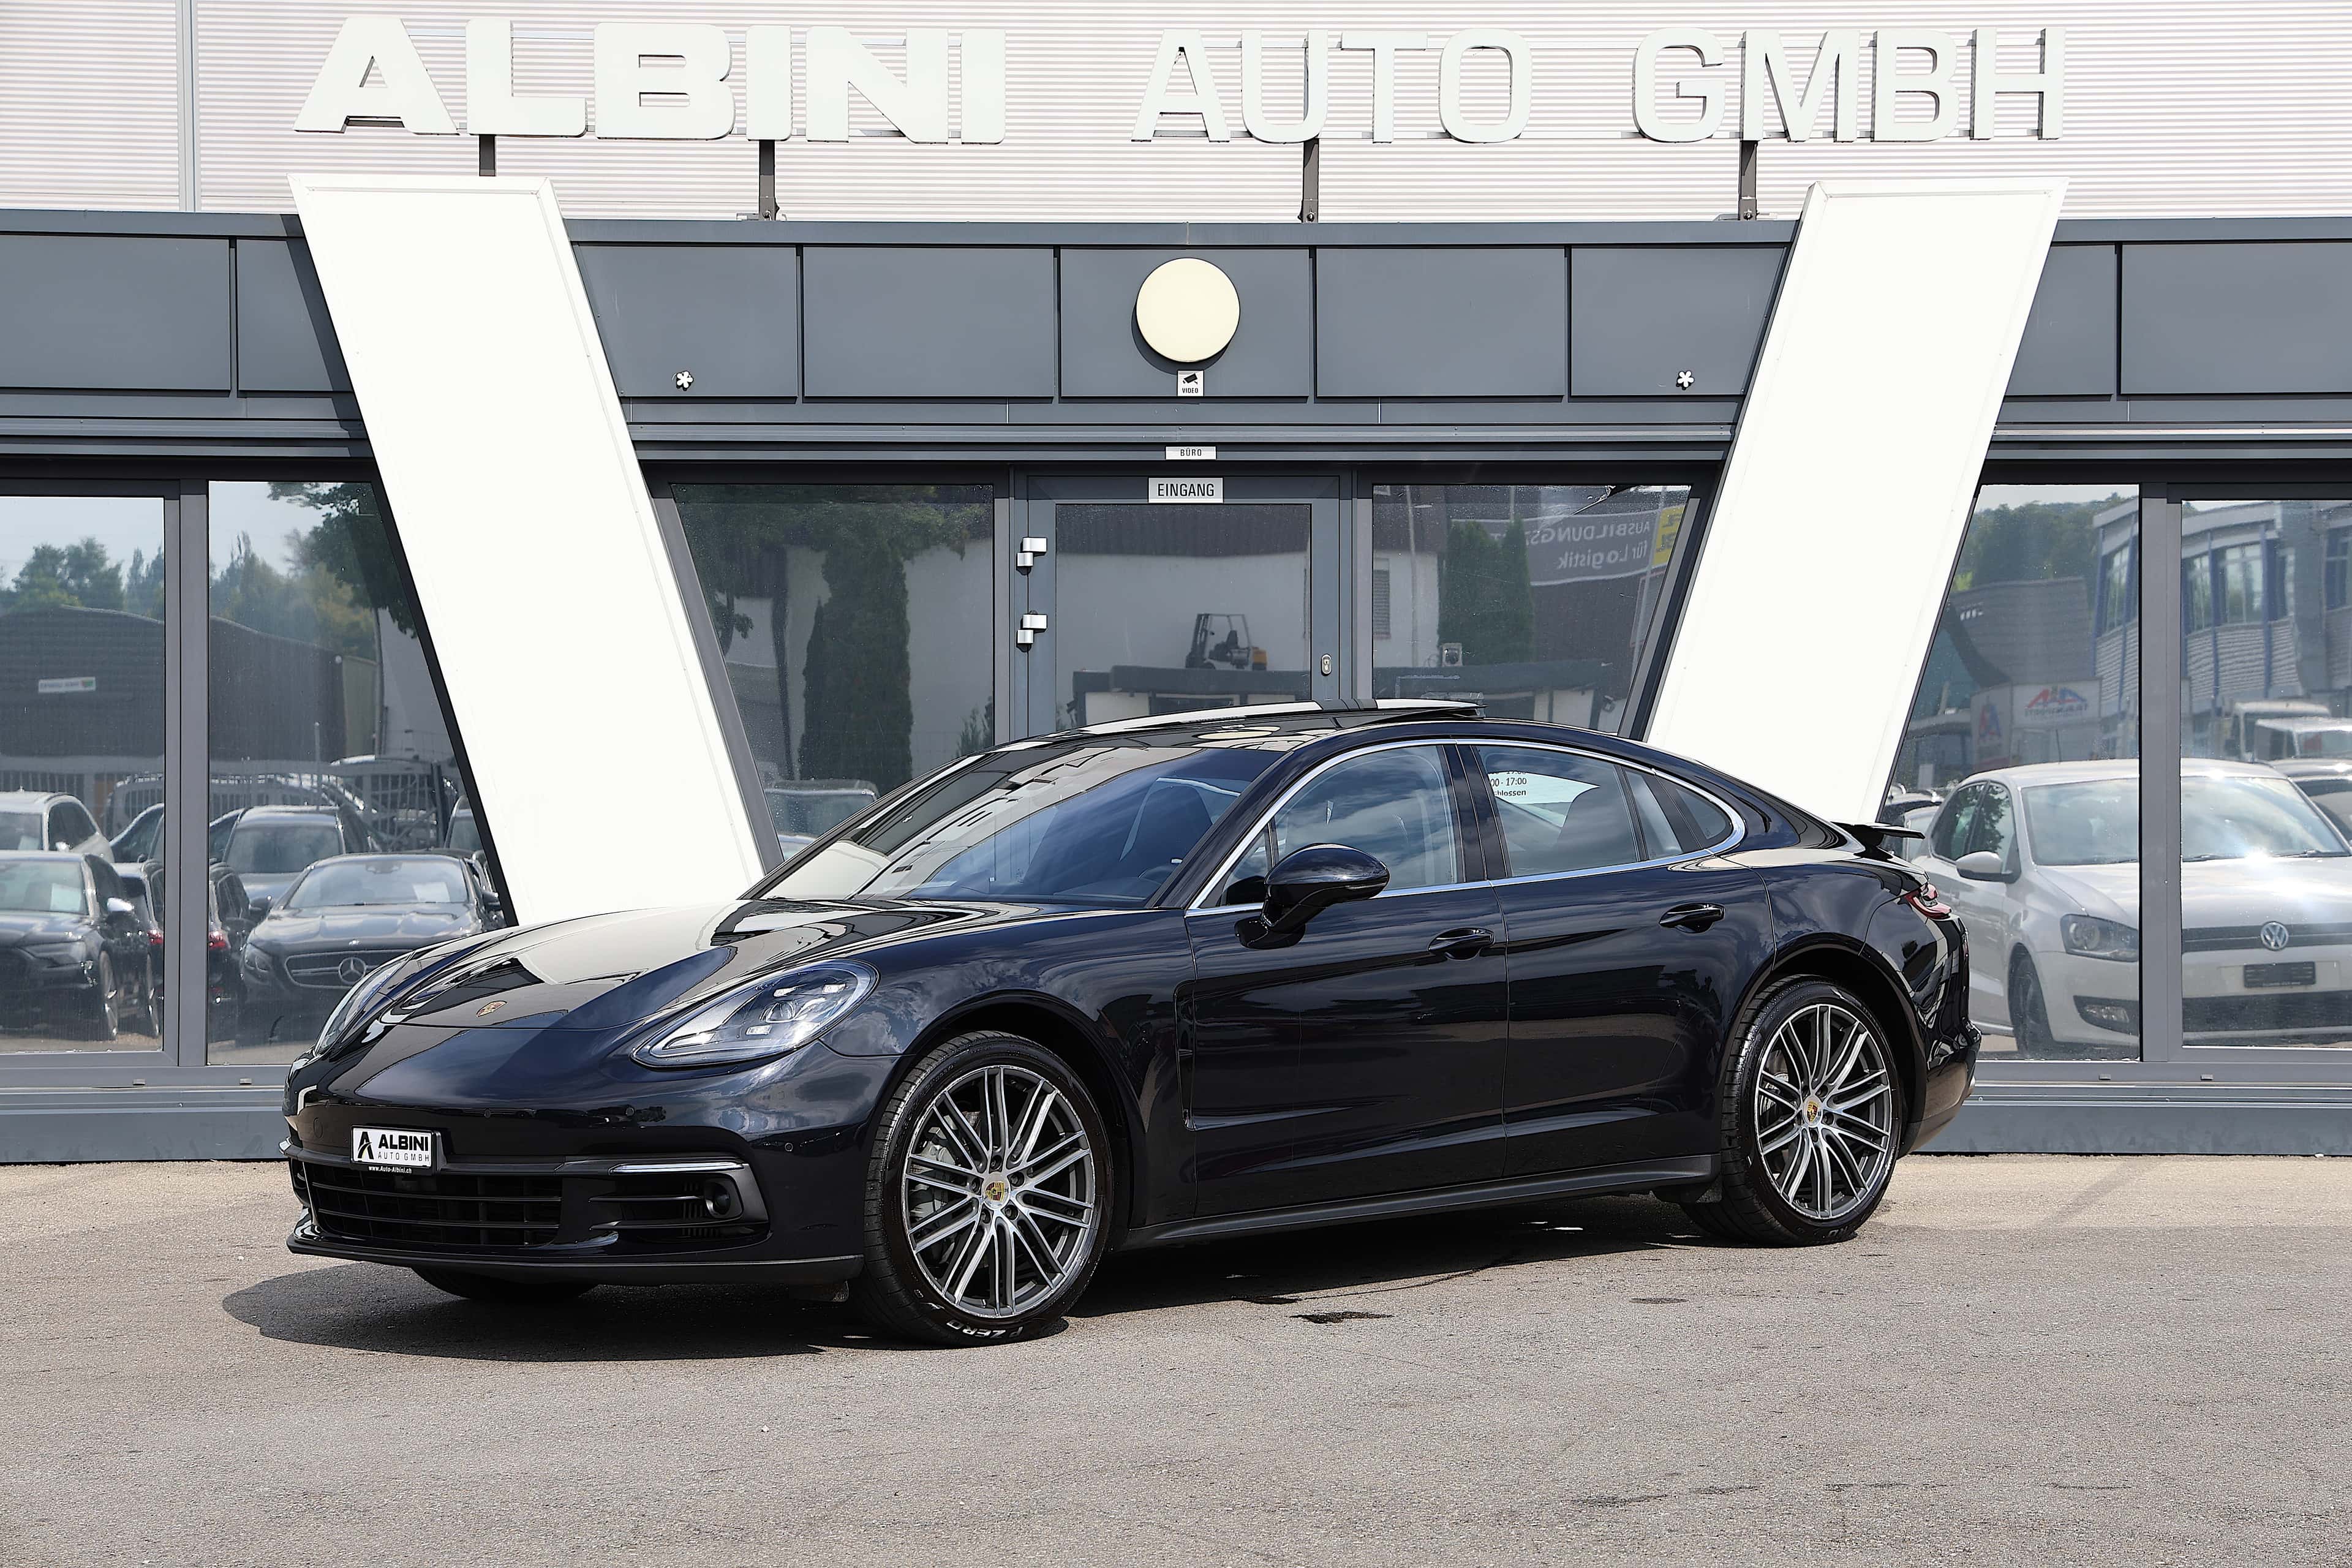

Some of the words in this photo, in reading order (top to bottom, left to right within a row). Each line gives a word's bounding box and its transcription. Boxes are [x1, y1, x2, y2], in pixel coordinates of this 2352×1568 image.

[293, 17, 1006, 145] ALBINI
[1131, 29, 1532, 143] AUTO
[1632, 27, 2067, 143] GMBH
[1180, 447, 1202, 456] BÜRO
[1158, 483, 1215, 497] EINGANG
[1506, 777, 1527, 786] 17:00
[378, 1134, 429, 1152] ALBINI
[378, 1152, 400, 1160] AUTO
[404, 1153, 429, 1162] GMBH
[368, 1166, 412, 1174] www.Auto-Albini.ch
[946, 1319, 1006, 1338] ZERO
